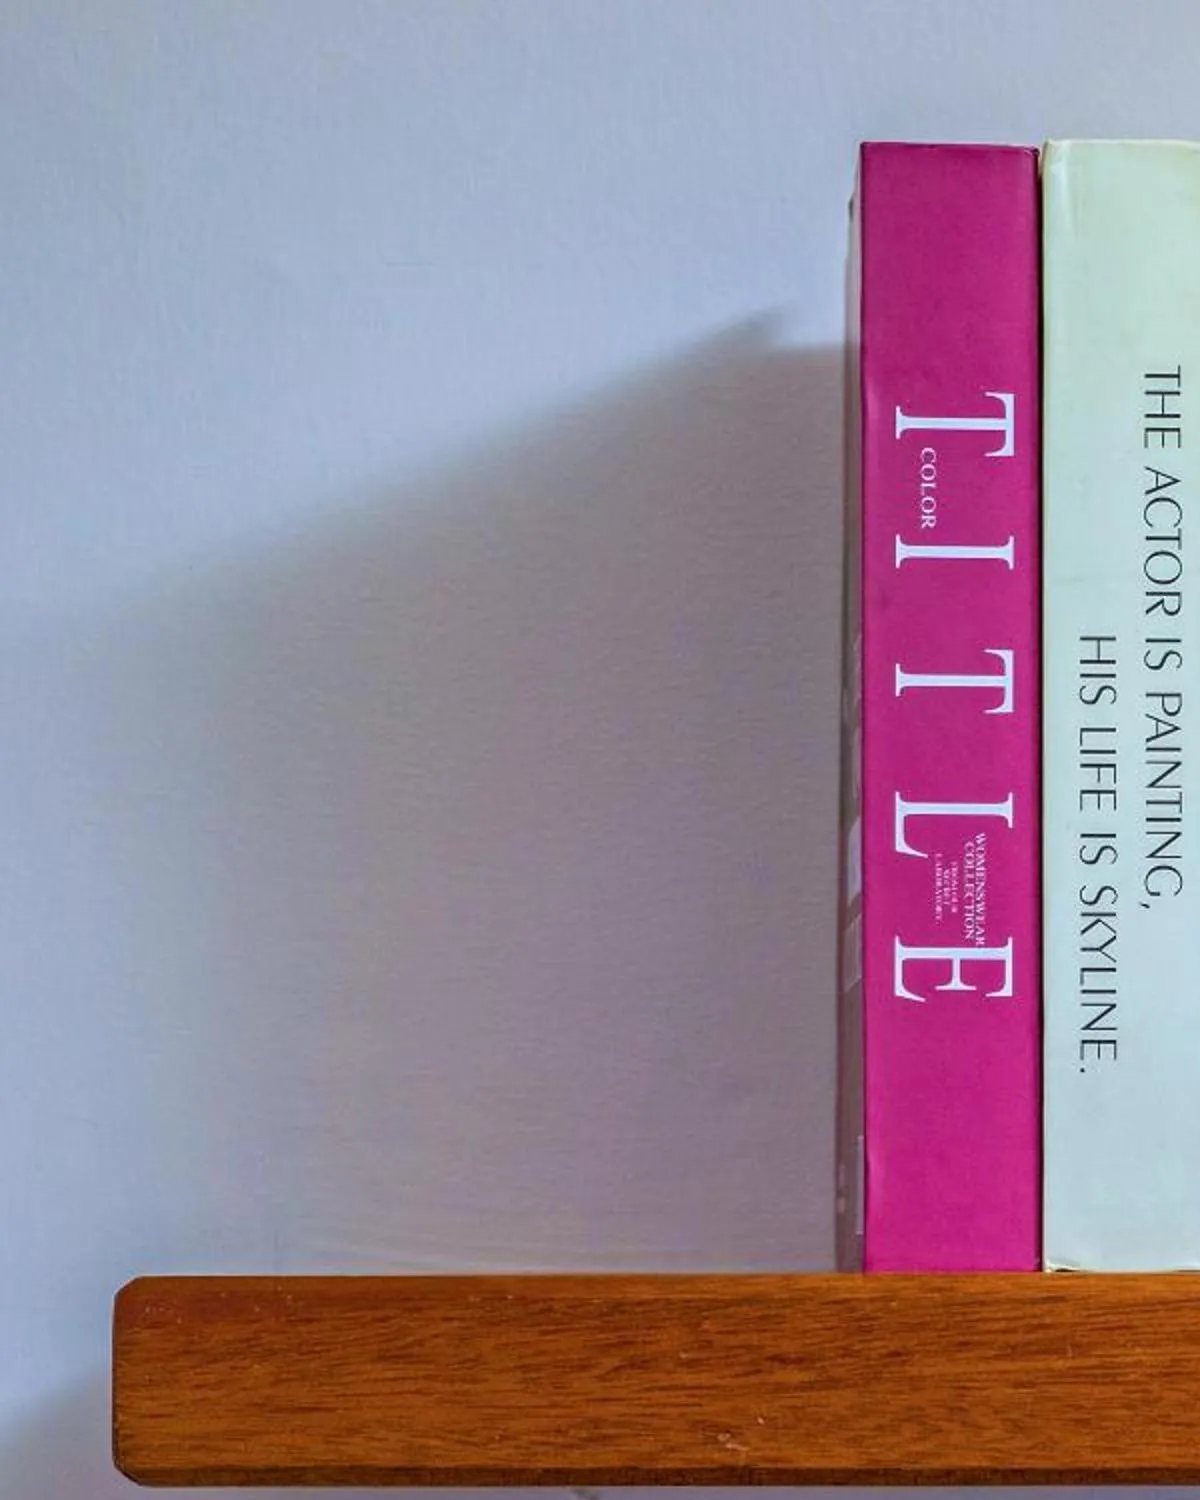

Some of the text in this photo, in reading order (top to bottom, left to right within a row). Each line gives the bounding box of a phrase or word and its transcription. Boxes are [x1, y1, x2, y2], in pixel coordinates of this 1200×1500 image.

[920, 447, 937, 529] COLOR
[895, 391, 1014, 1002] TITLE
[1138, 365, 1183, 909] THE ACTOR IS PAINTING,
[964, 841, 975, 940] COLLECTION
[975, 832, 987, 946] WOMENSWEAR
[1079, 636, 1118, 1073] HIS LIFE IS SKYLINE.
